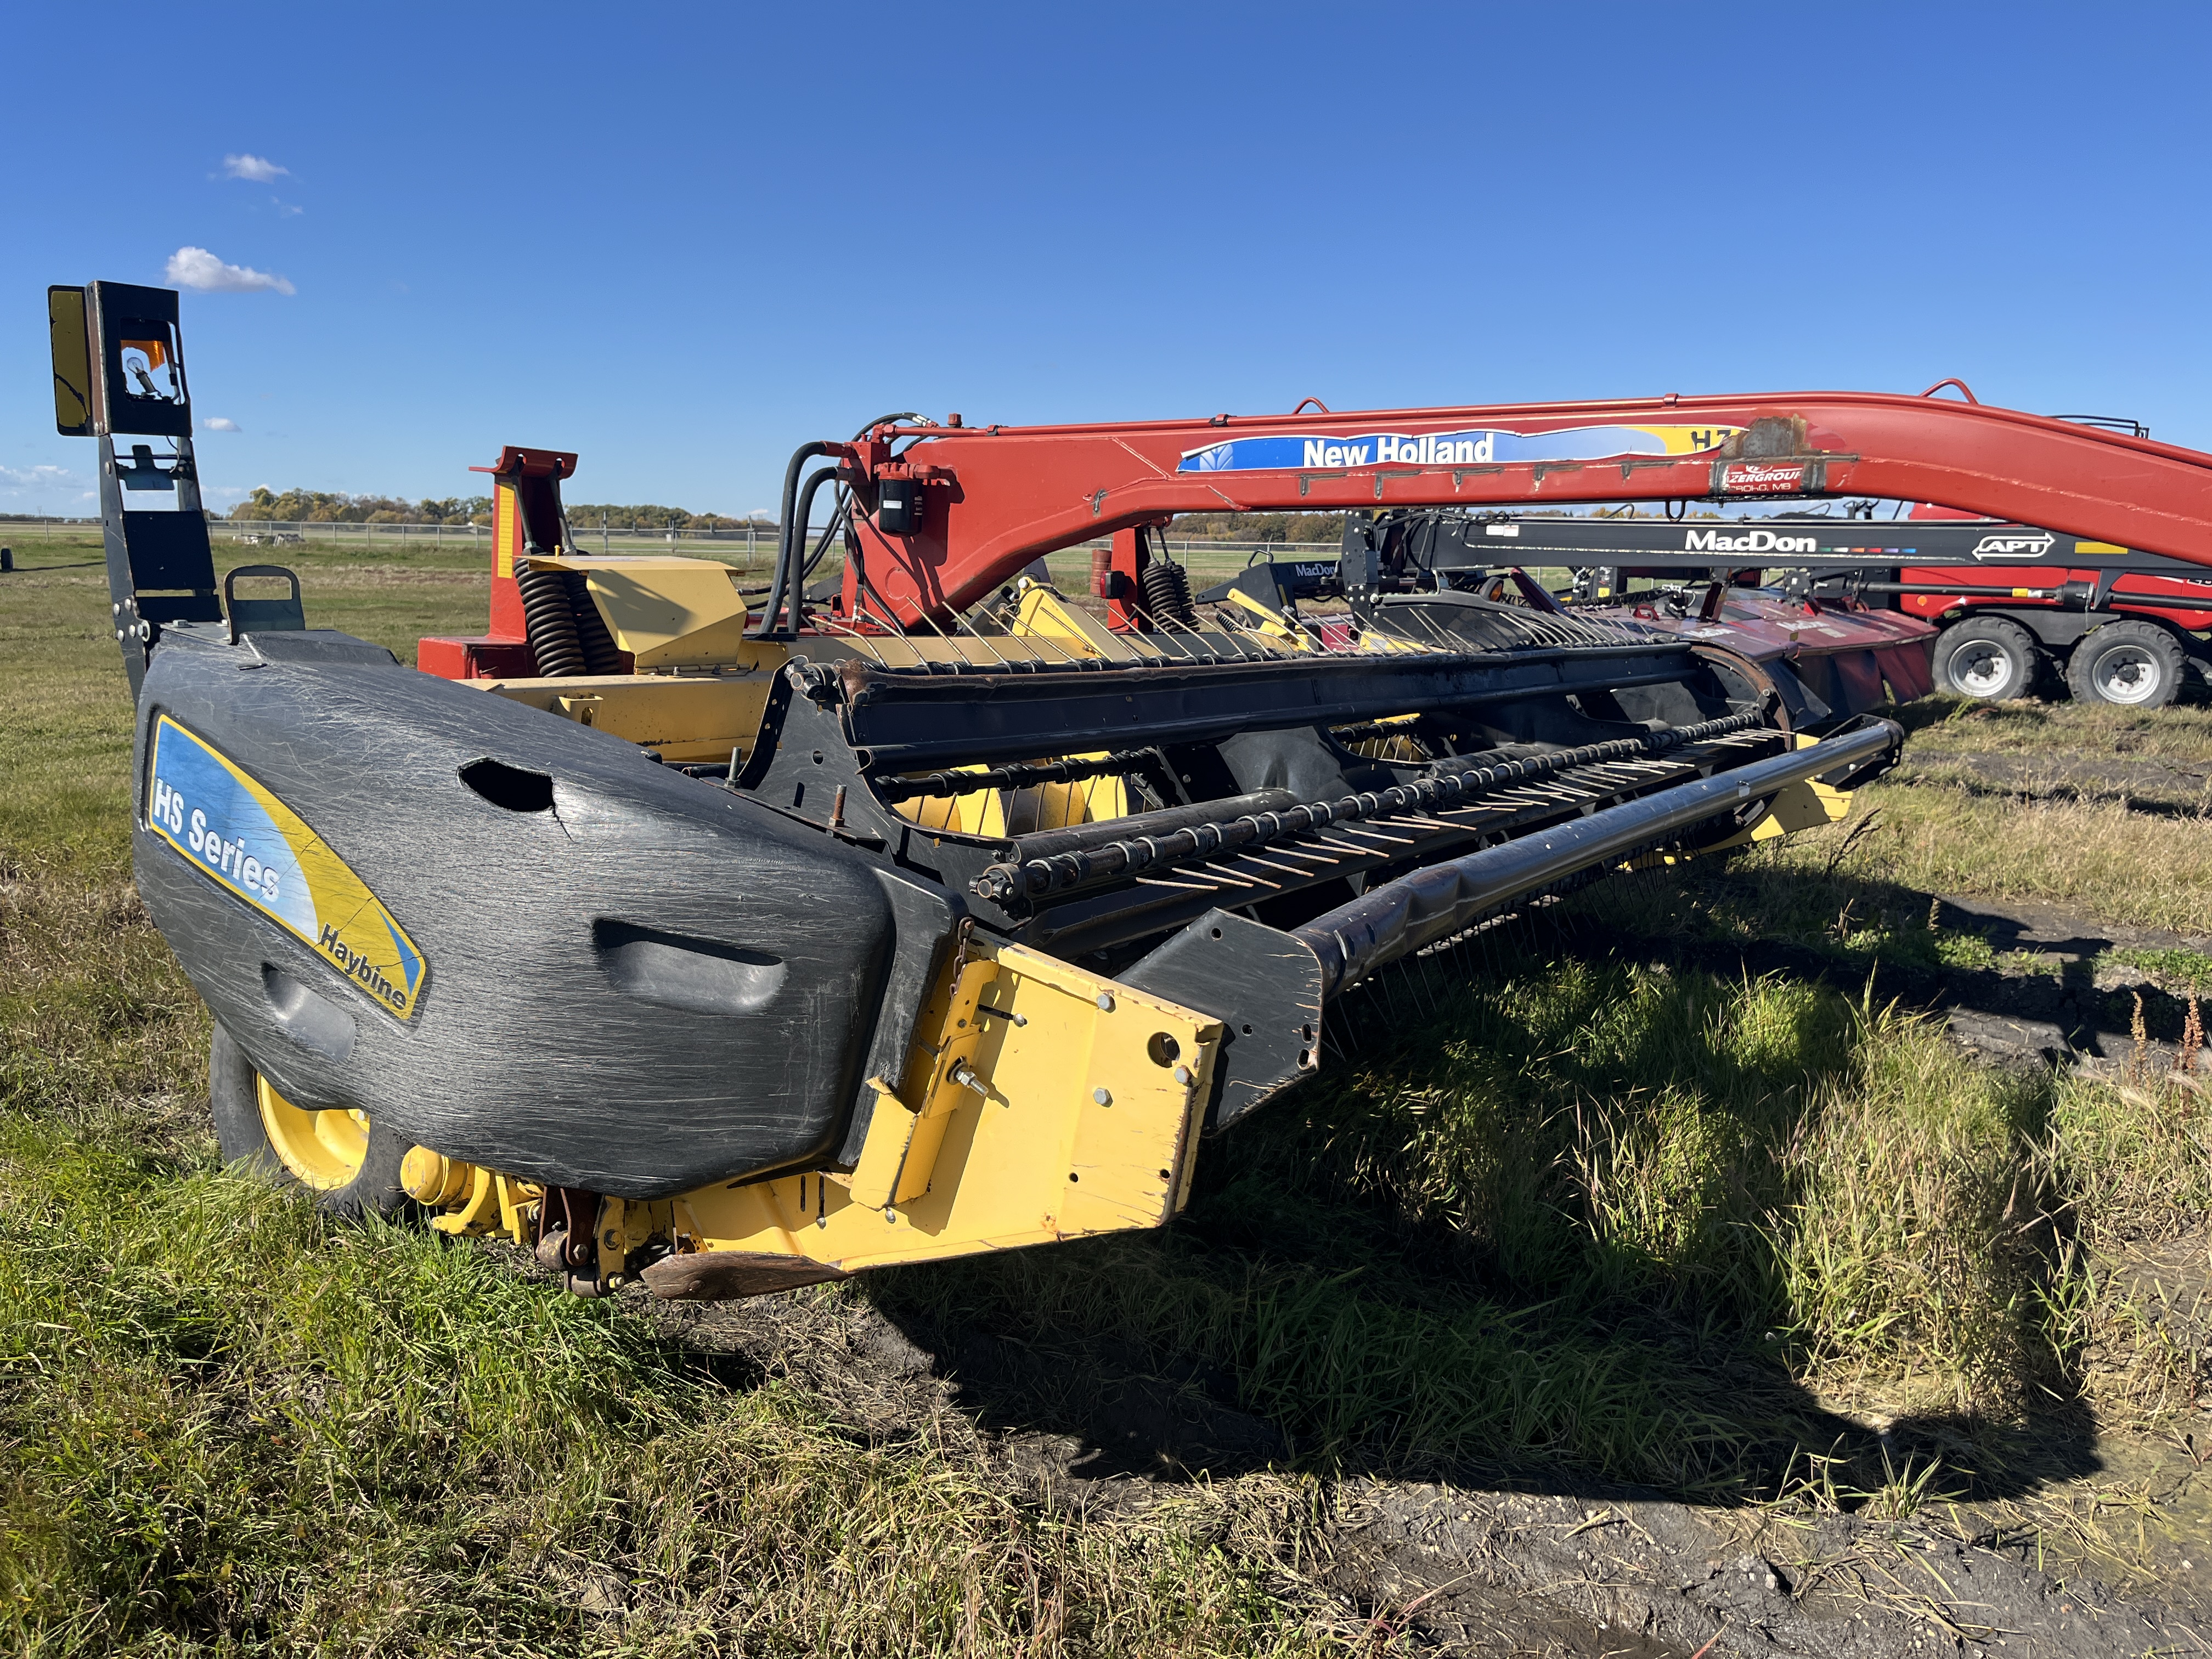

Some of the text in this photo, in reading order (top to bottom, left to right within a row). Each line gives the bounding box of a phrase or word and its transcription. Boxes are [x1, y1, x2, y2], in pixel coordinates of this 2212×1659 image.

[1303, 439, 1369, 467] New
[1377, 432, 1494, 463] Holland
[1726, 471, 1801, 483] ZERGROU
[1772, 482, 1791, 491] MB
[1685, 529, 1817, 552] MacDon
[1982, 540, 2046, 553] APT
[1295, 563, 1335, 577] MacDon
[154, 777, 280, 903] HS Series
[319, 923, 408, 1009] Haybine
